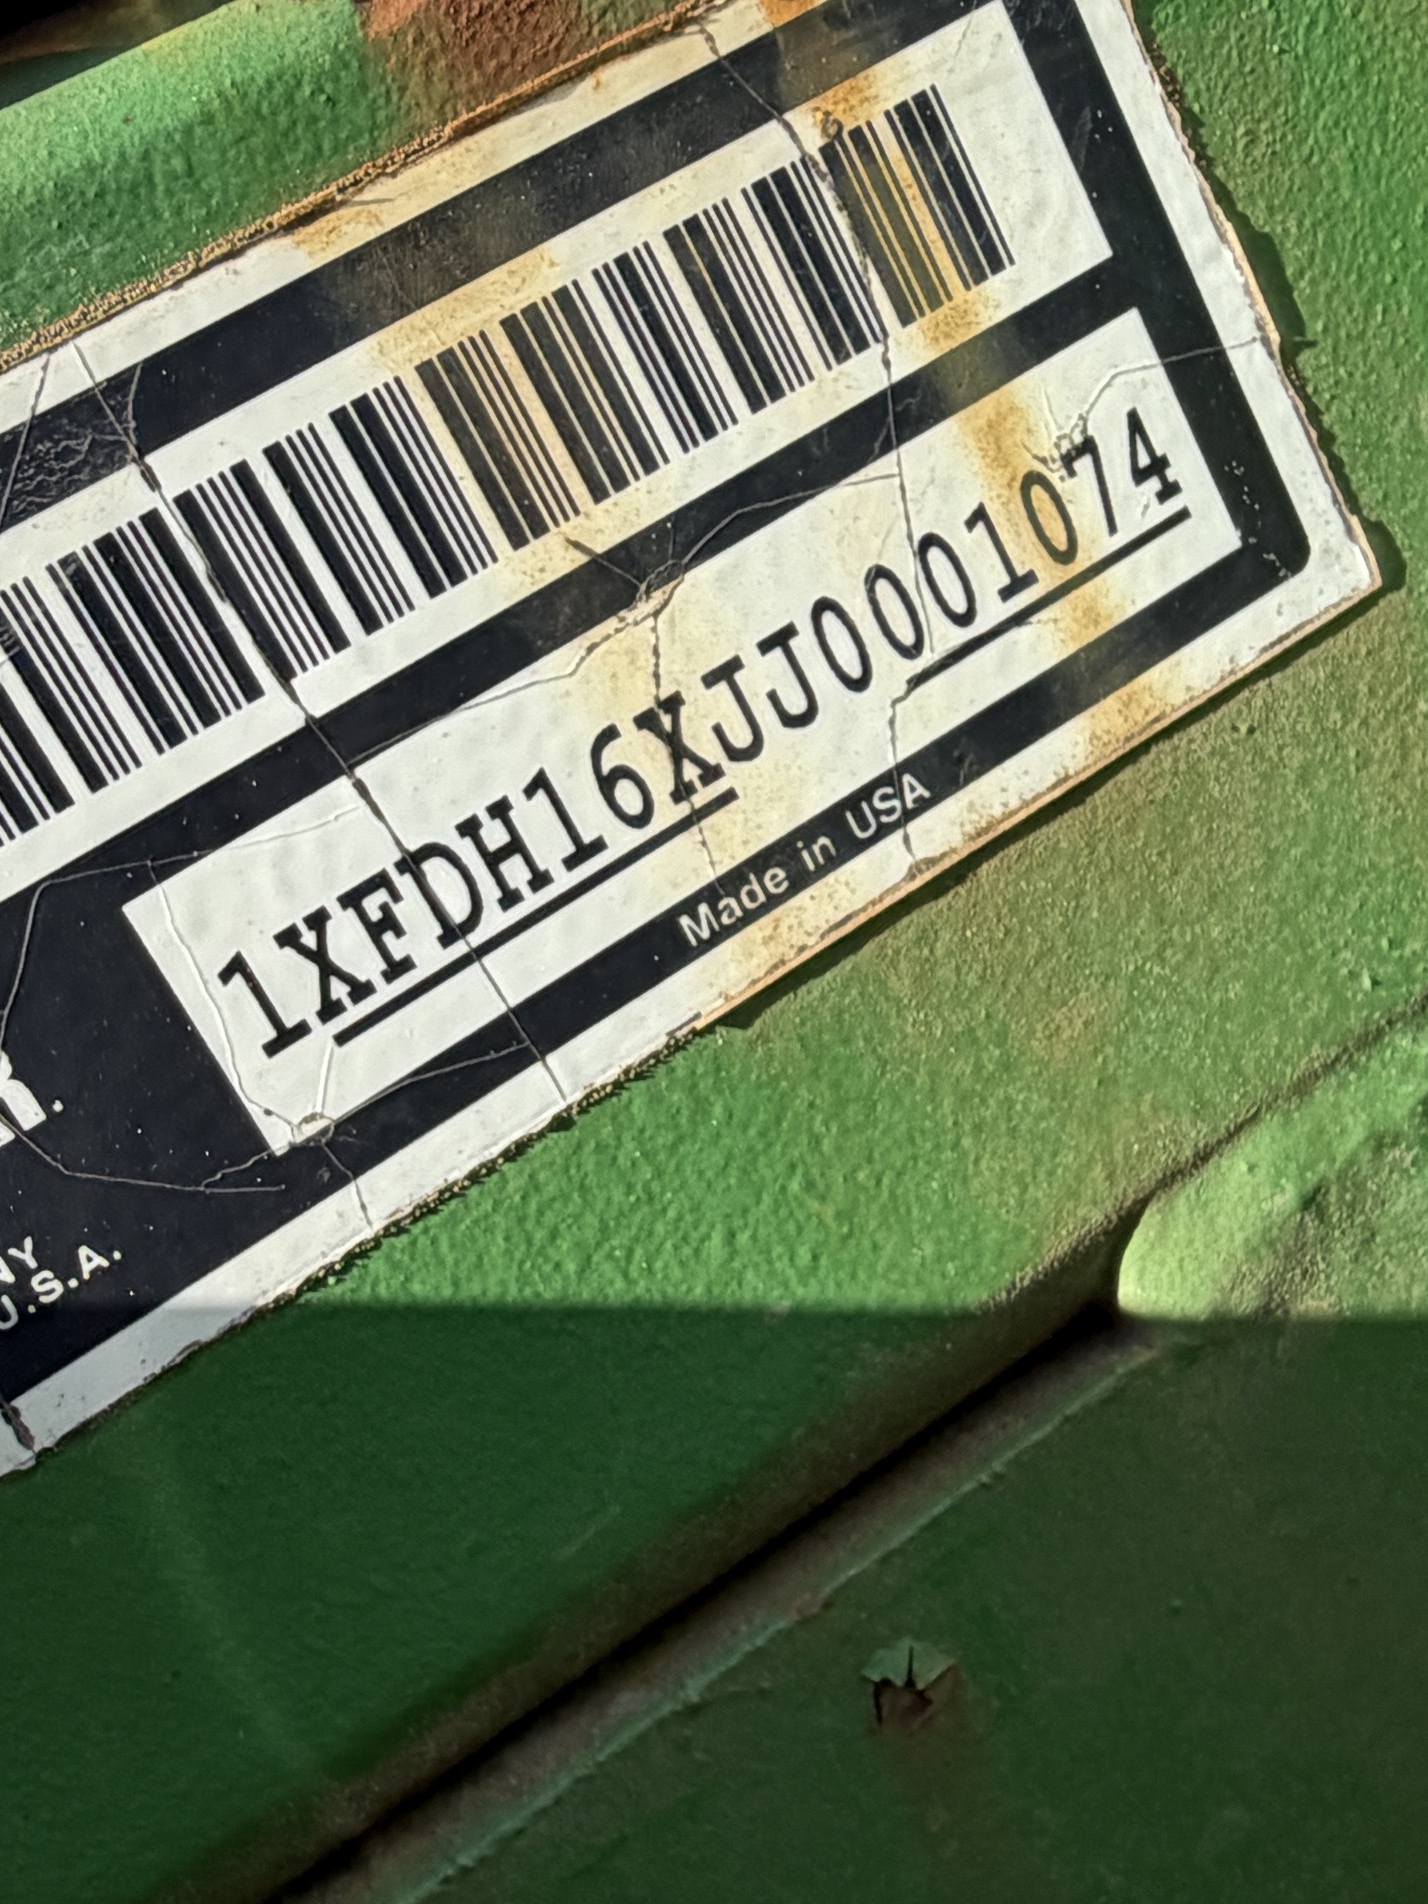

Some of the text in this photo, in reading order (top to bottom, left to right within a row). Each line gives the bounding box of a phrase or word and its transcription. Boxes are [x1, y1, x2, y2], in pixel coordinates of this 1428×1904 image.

[217, 404, 1184, 1060] 1XFDH16XJJ0001074
[677, 770, 933, 948] Made in USA
